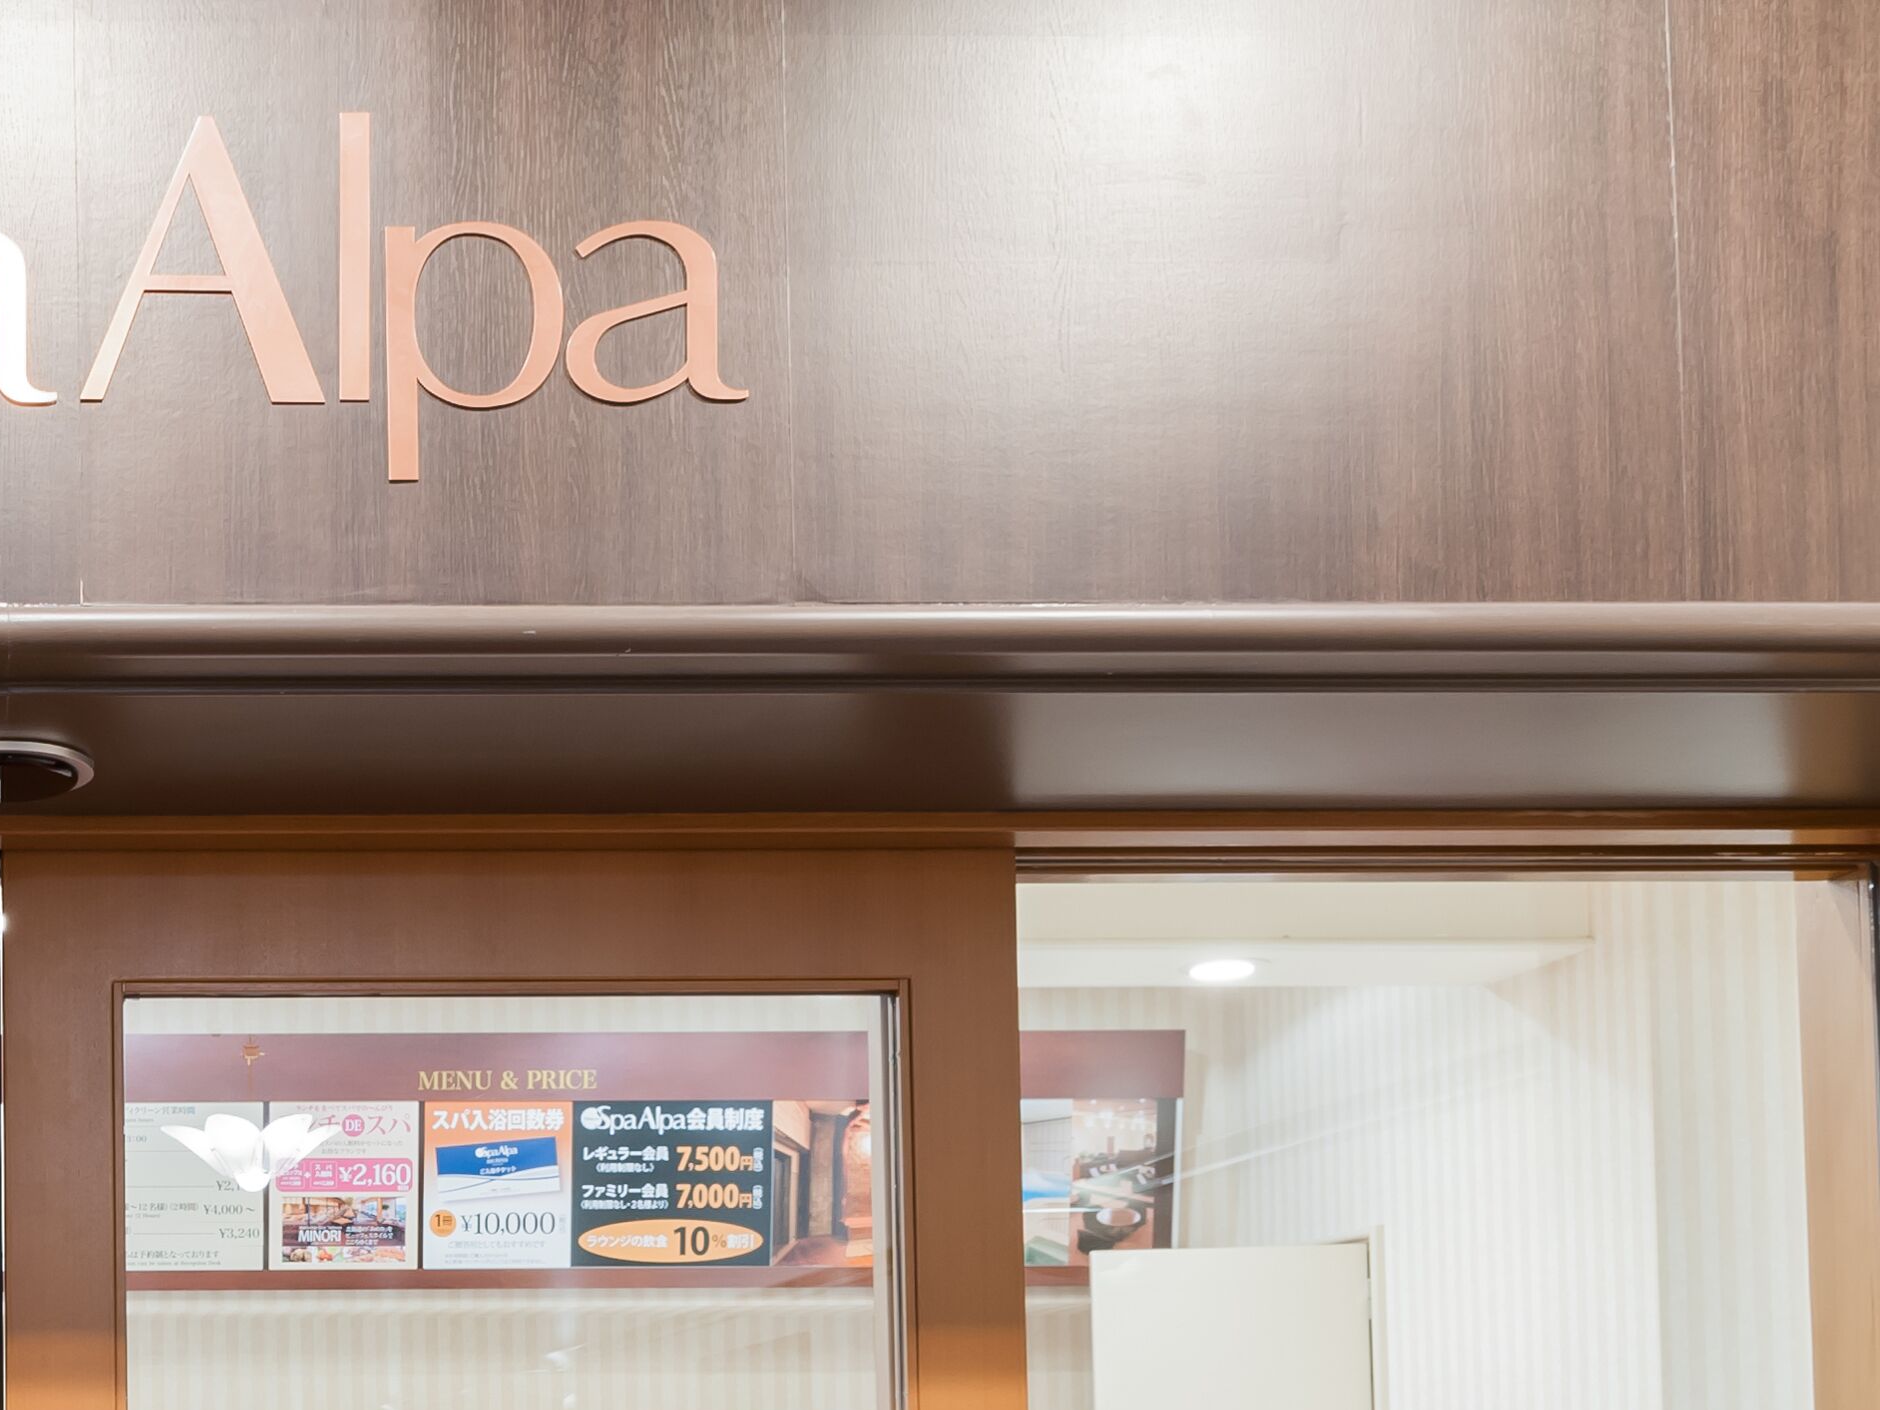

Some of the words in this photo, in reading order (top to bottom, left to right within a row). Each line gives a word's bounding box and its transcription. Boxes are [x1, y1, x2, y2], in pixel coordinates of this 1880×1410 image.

[78, 110, 750, 484] Alpa
[418, 1070, 492, 1090] MENU
[500, 1070, 519, 1090] &
[527, 1069, 597, 1090] PRICE
[432, 1109, 565, 1131] スパ入浴回数券
[686, 1107, 765, 1132] 会員制度
[583, 1146, 669, 1161] レギュラー会員
[676, 1146, 753, 1172] 7,500円
[339, 1163, 411, 1186] ¥2,160
[582, 1183, 668, 1198] ファミリー会員
[676, 1183, 752, 1209] 7,000円
[219, 1228, 260, 1239] ¥3,240
[460, 1212, 555, 1236] ¥10,000
[298, 1229, 342, 1242] MINORI
